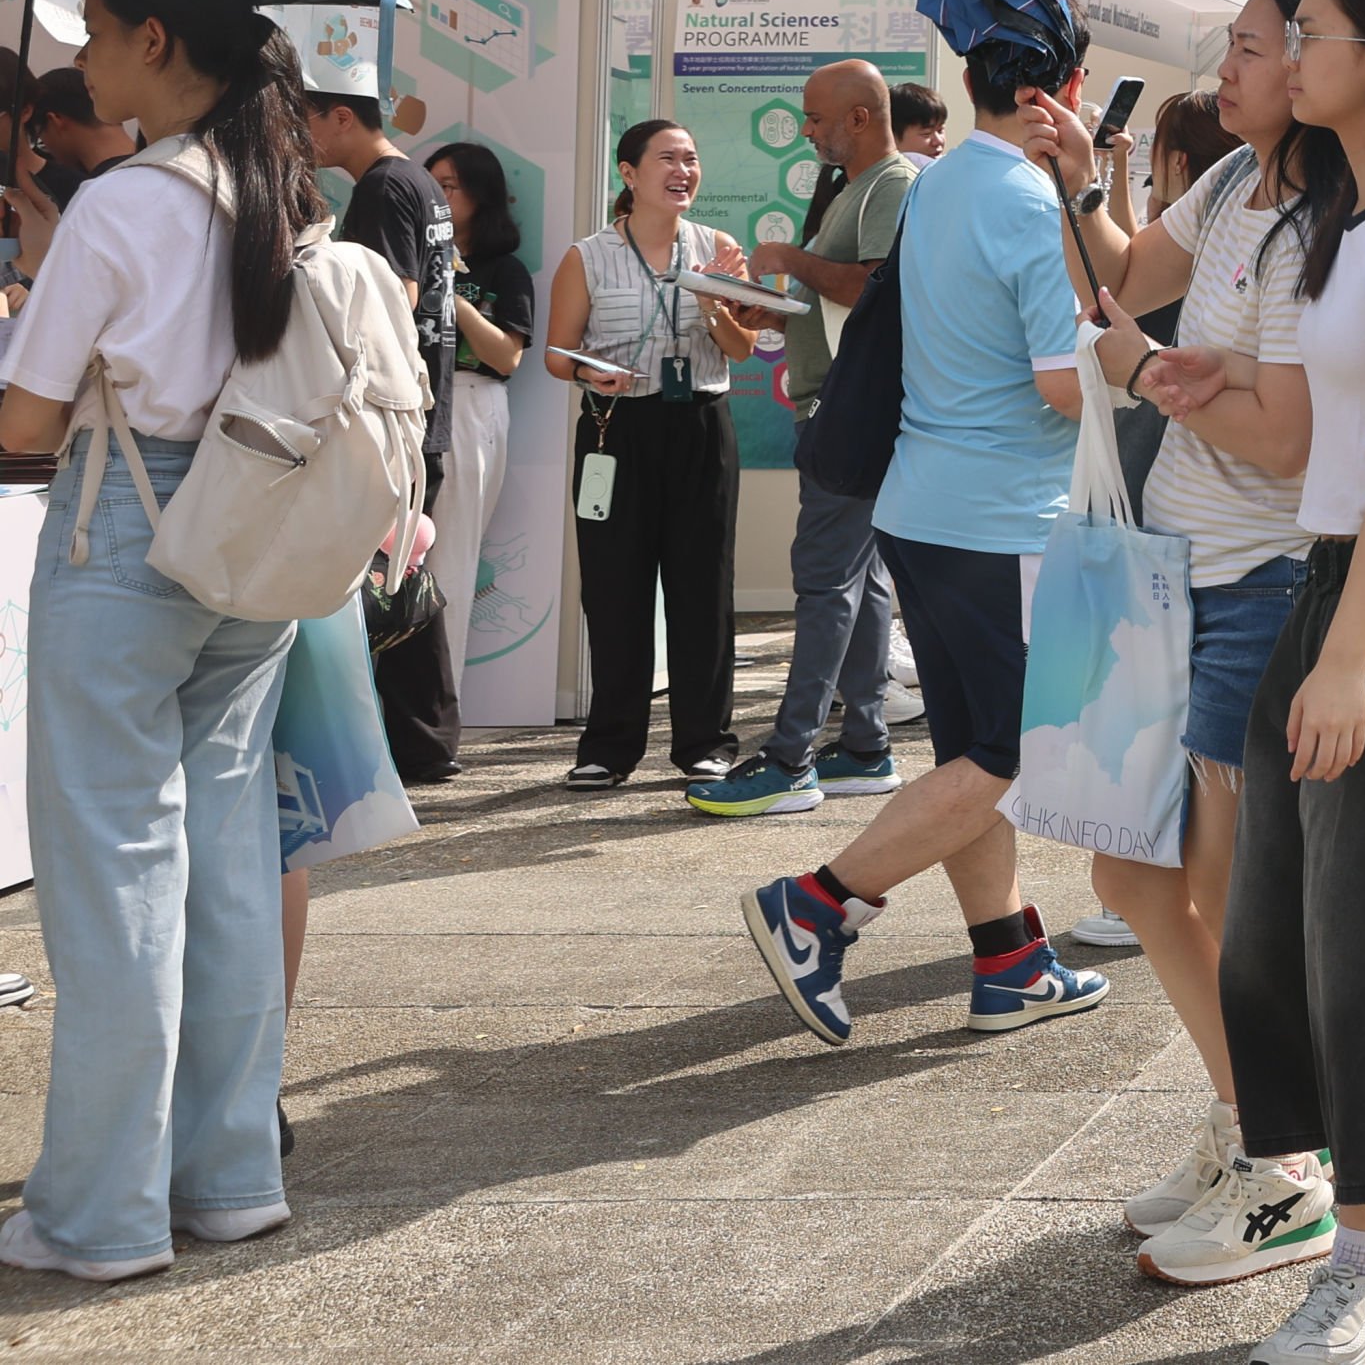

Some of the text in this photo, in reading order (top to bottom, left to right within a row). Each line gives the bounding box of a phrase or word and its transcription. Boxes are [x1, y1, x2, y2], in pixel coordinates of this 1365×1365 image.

[684, 12, 840, 28] Natural Sciences
[683, 31, 809, 47] PROGRAMME
[683, 83, 804, 94] Seven Concentrations
[689, 207, 729, 218] Studies
[1060, 814, 1113, 852] INFO
[1118, 826, 1161, 858] DAY
